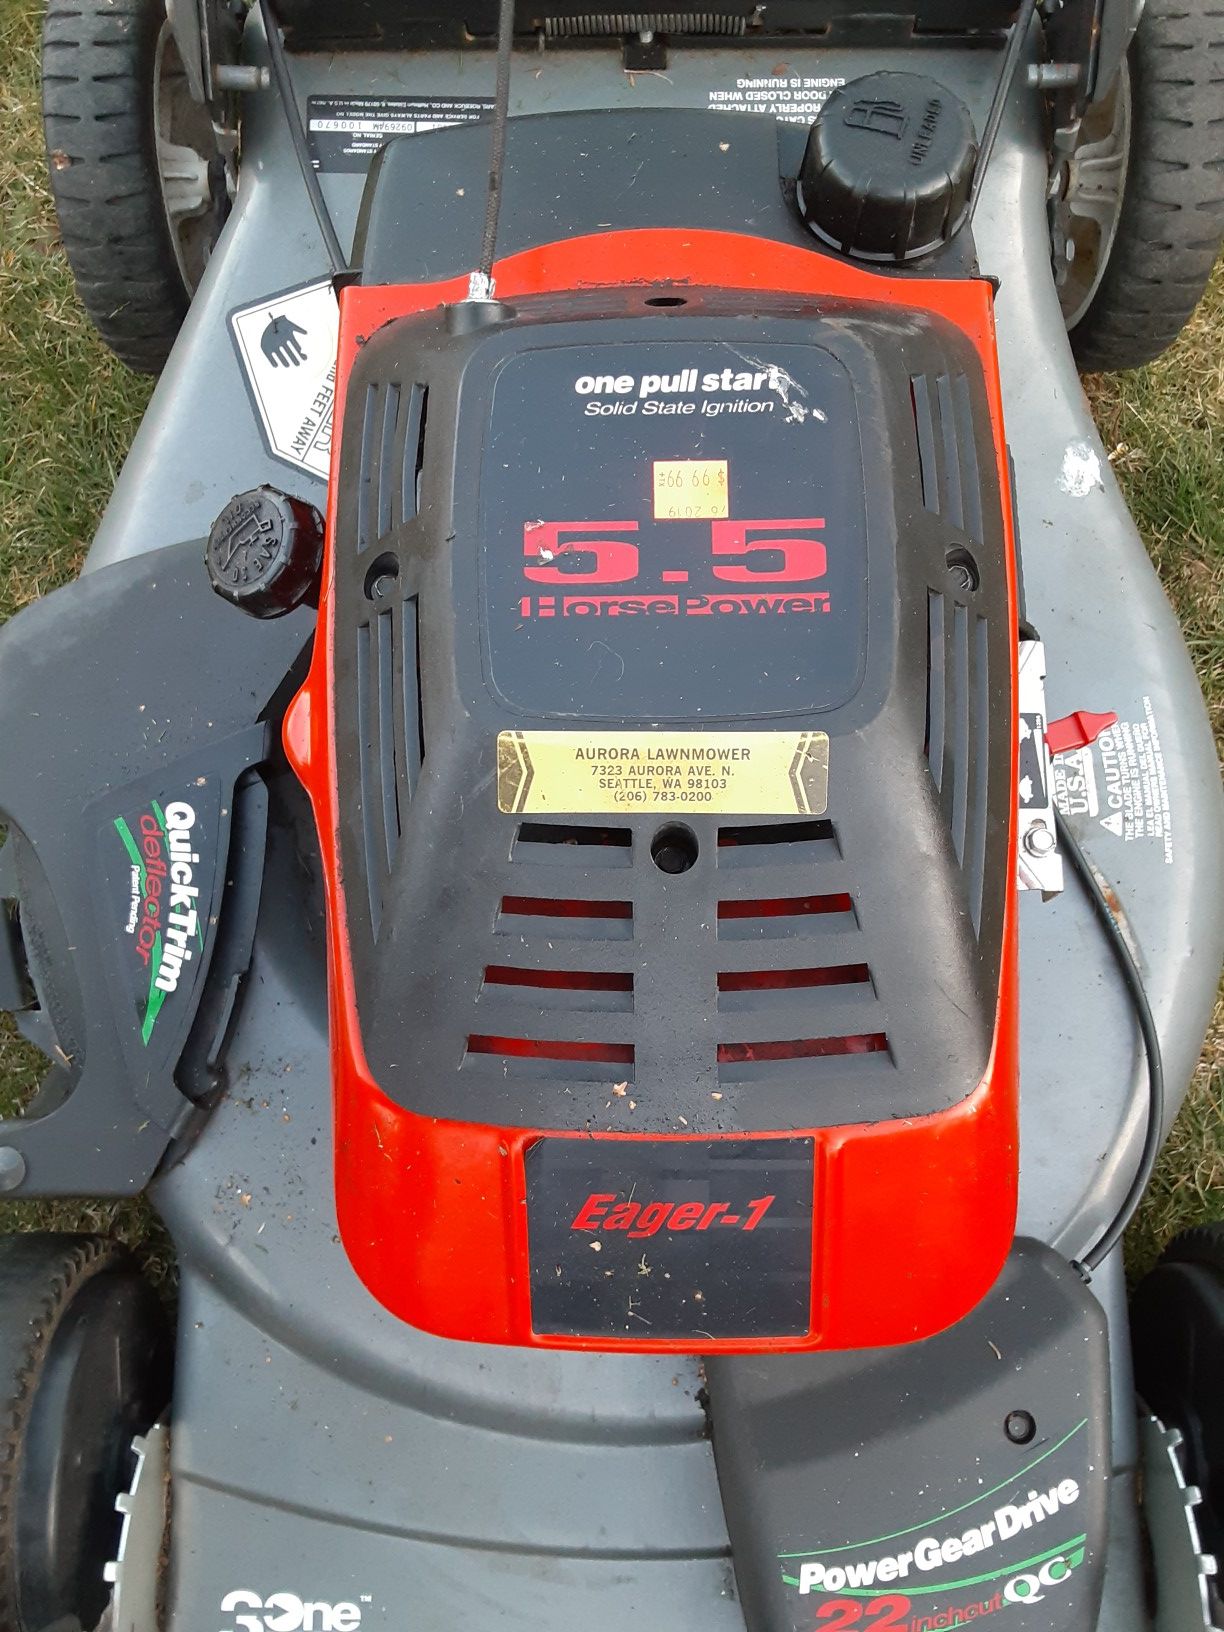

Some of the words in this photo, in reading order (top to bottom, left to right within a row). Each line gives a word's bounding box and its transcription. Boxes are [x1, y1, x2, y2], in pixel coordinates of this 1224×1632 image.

[737, 79, 787, 88] RUNNING
[790, 79, 801, 88] IS
[794, 90, 827, 99] DOOR
[803, 78, 845, 88] ENGINE
[709, 92, 743, 100] WHEN
[746, 91, 791, 100] CLOSED
[769, 103, 821, 113] ROPERLY
[317, 120, 362, 129] 100670
[574, 374, 634, 394] one
[639, 369, 698, 398] pull
[701, 368, 779, 393] start
[310, 385, 333, 417] FEET
[584, 401, 637, 416] Solid
[641, 401, 696, 415] State
[701, 399, 774, 417] Ignition
[290, 417, 316, 455] AWAY
[523, 518, 828, 584] 5.5
[1140, 722, 1150, 739] FOR
[1143, 696, 1160, 751] INFORMATION
[575, 747, 640, 760] AURORA
[647, 748, 751, 761] LAWNMOWER
[1121, 722, 1137, 766] RUNNING
[1117, 752, 1131, 784] TURNS
[1138, 753, 1147, 769] DEL
[1144, 741, 1156, 775] MANUAL
[591, 765, 623, 776] 7323
[629, 766, 682, 776] AURORA
[687, 766, 718, 776] AVE.
[721, 766, 734, 776] N.
[1129, 768, 1139, 777] IS
[1154, 752, 1171, 811] MAINTENANCE
[599, 779, 656, 790] SEATTLE,
[662, 779, 681, 789] WA
[687, 779, 727, 789] 98103
[1054, 769, 1071, 816] MADE
[1142, 772, 1152, 806] MANUAL
[1150, 777, 1161, 812] OWNERS
[614, 791, 647, 803] (206)
[653, 791, 712, 802] 783-0200
[1122, 786, 1134, 820] BLADE
[1130, 780, 1143, 816] ENGINE
[1145, 807, 1154, 818] EL
[1162, 812, 1171, 830] AND
[1124, 821, 1134, 841] THE
[1134, 818, 1144, 838] THE
[1146, 820, 1155, 836] LEA
[1153, 814, 1163, 837] READ
[1163, 831, 1173, 864] SAFETY
[130, 864, 140, 894] Patent
[136, 815, 166, 966] deflector
[154, 801, 200, 993] QuickTrim
[125, 895, 140, 934] Pending
[571, 1193, 776, 1239] Eager-1
[815, 1594, 912, 1632] 22
[1003, 1556, 1072, 1604] QC
